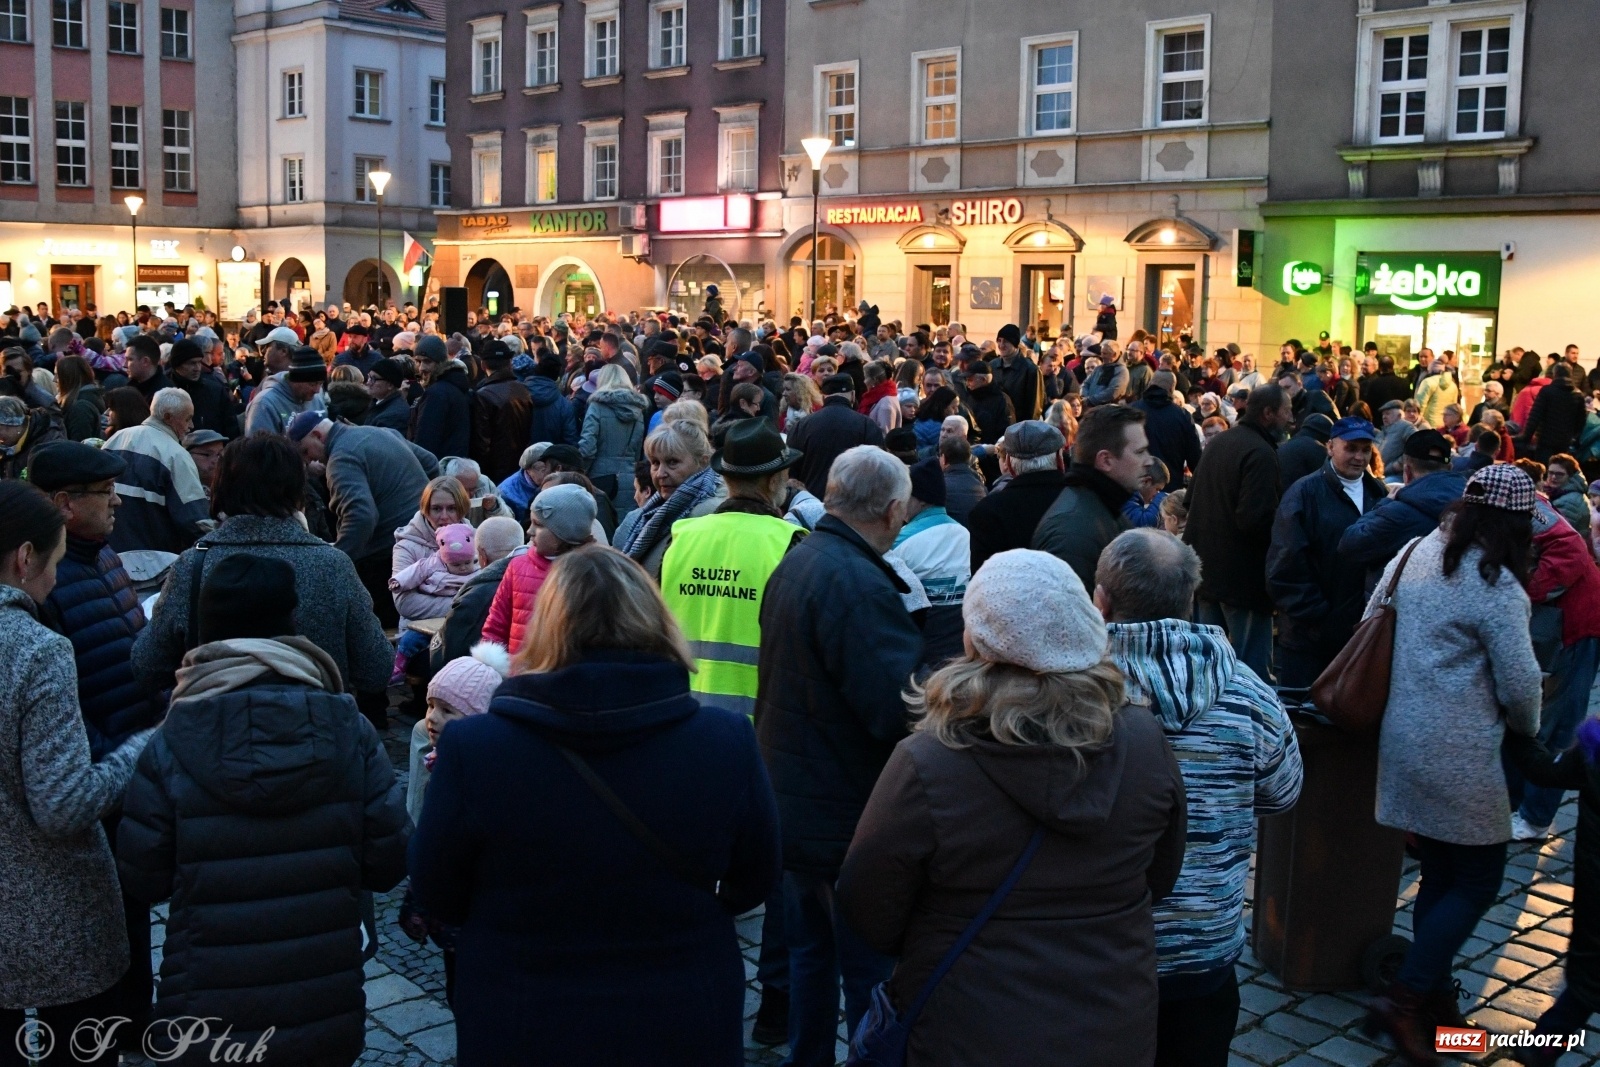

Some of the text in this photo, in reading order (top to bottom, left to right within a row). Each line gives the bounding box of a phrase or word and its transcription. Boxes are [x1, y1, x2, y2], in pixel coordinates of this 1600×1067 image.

[461, 216, 508, 227] TABAC
[531, 210, 606, 232] KANTOR
[827, 200, 1022, 225] RESTAURACJA SHIRO
[1373, 263, 1481, 296] żabka
[692, 566, 740, 581] SŁUŻBY
[679, 583, 757, 601] KOMUNALNE
